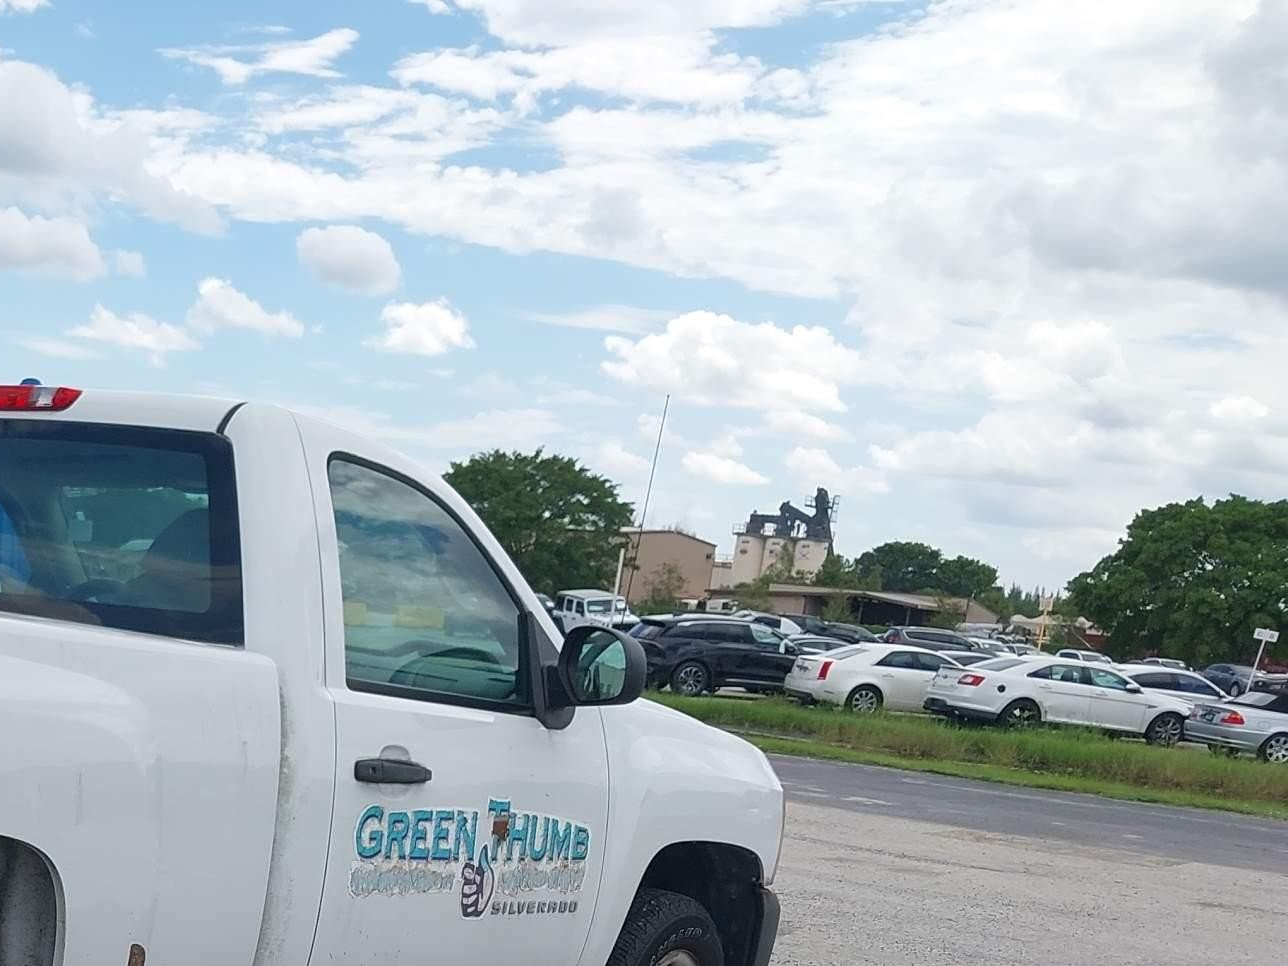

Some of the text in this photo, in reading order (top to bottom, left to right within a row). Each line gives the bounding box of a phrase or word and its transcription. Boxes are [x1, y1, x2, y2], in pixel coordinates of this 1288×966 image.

[355, 799, 591, 862] GREEN THUMB
[489, 900, 579, 915] SILVERADO
